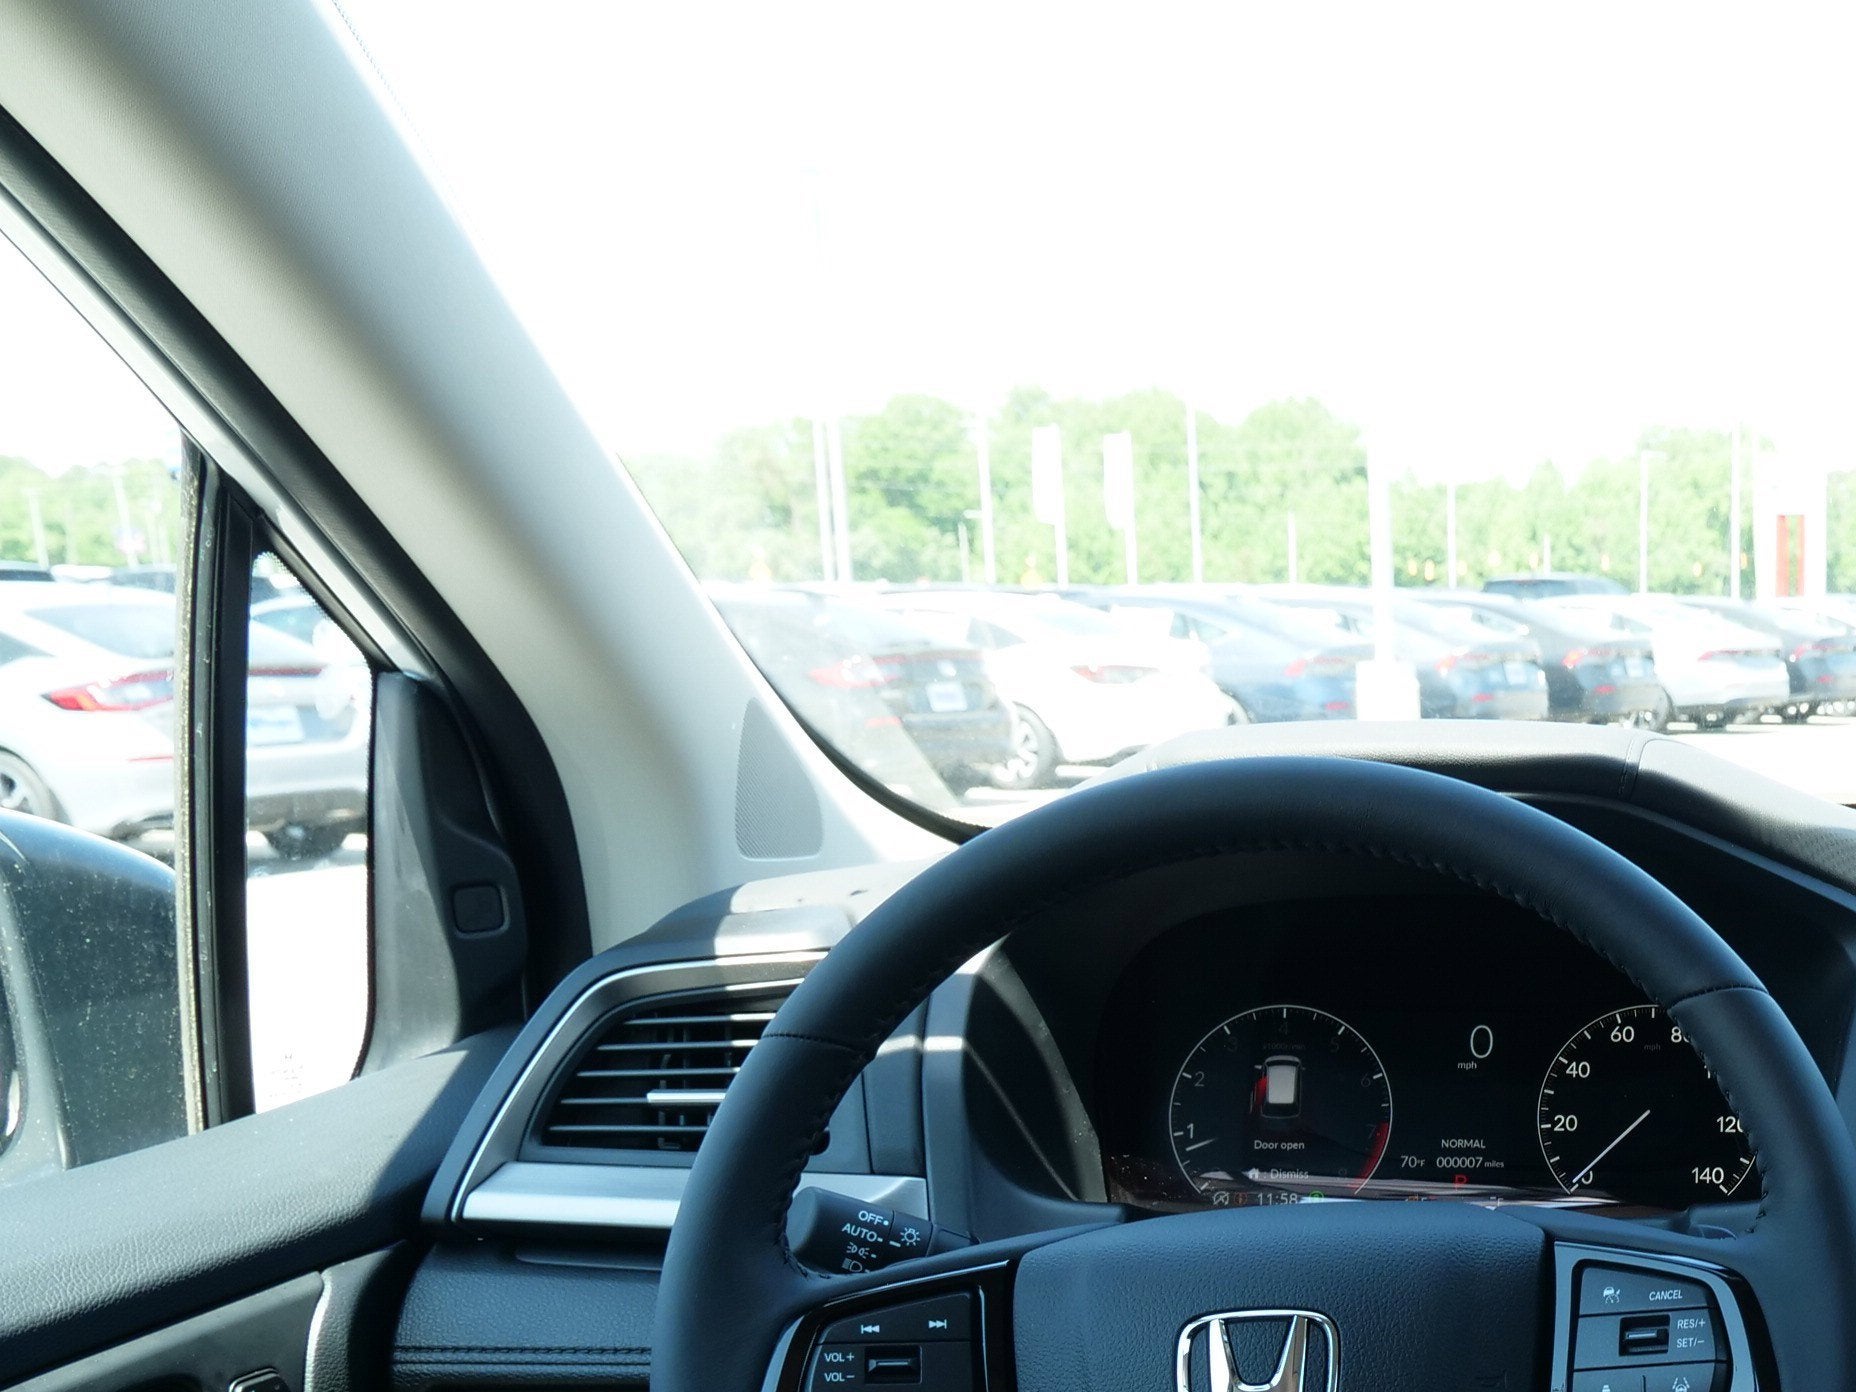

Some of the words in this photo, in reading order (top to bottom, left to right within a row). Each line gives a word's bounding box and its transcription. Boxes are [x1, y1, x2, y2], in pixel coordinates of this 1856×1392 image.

[1470, 1024, 1493, 1058] 0
[1610, 1026, 1635, 1043] 60
[1671, 1026, 1690, 1043] 8
[1644, 1043, 1661, 1052] mph
[1457, 1061, 1477, 1071] mph
[1566, 1062, 1590, 1079] 40
[1195, 1072, 1205, 1087] 2
[1361, 1074, 1371, 1088] 6
[1553, 1115, 1578, 1132] 20
[1187, 1123, 1194, 1139] 1
[1254, 1140, 1279, 1150] Door
[1281, 1141, 1305, 1152] open
[1441, 1139, 1486, 1149] NORMAL
[1436, 1156, 1483, 1169] 000007
[1484, 1160, 1505, 1168] miles
[1270, 1169, 1309, 1179] Dismiss
[1691, 1166, 1725, 1184] 140
[1453, 1175, 1468, 1188] P
[1257, 1192, 1298, 1205] 11:58
[858, 1210, 883, 1225] OFF
[842, 1223, 877, 1242] AUTO
[1649, 1289, 1683, 1301] CANCEL
